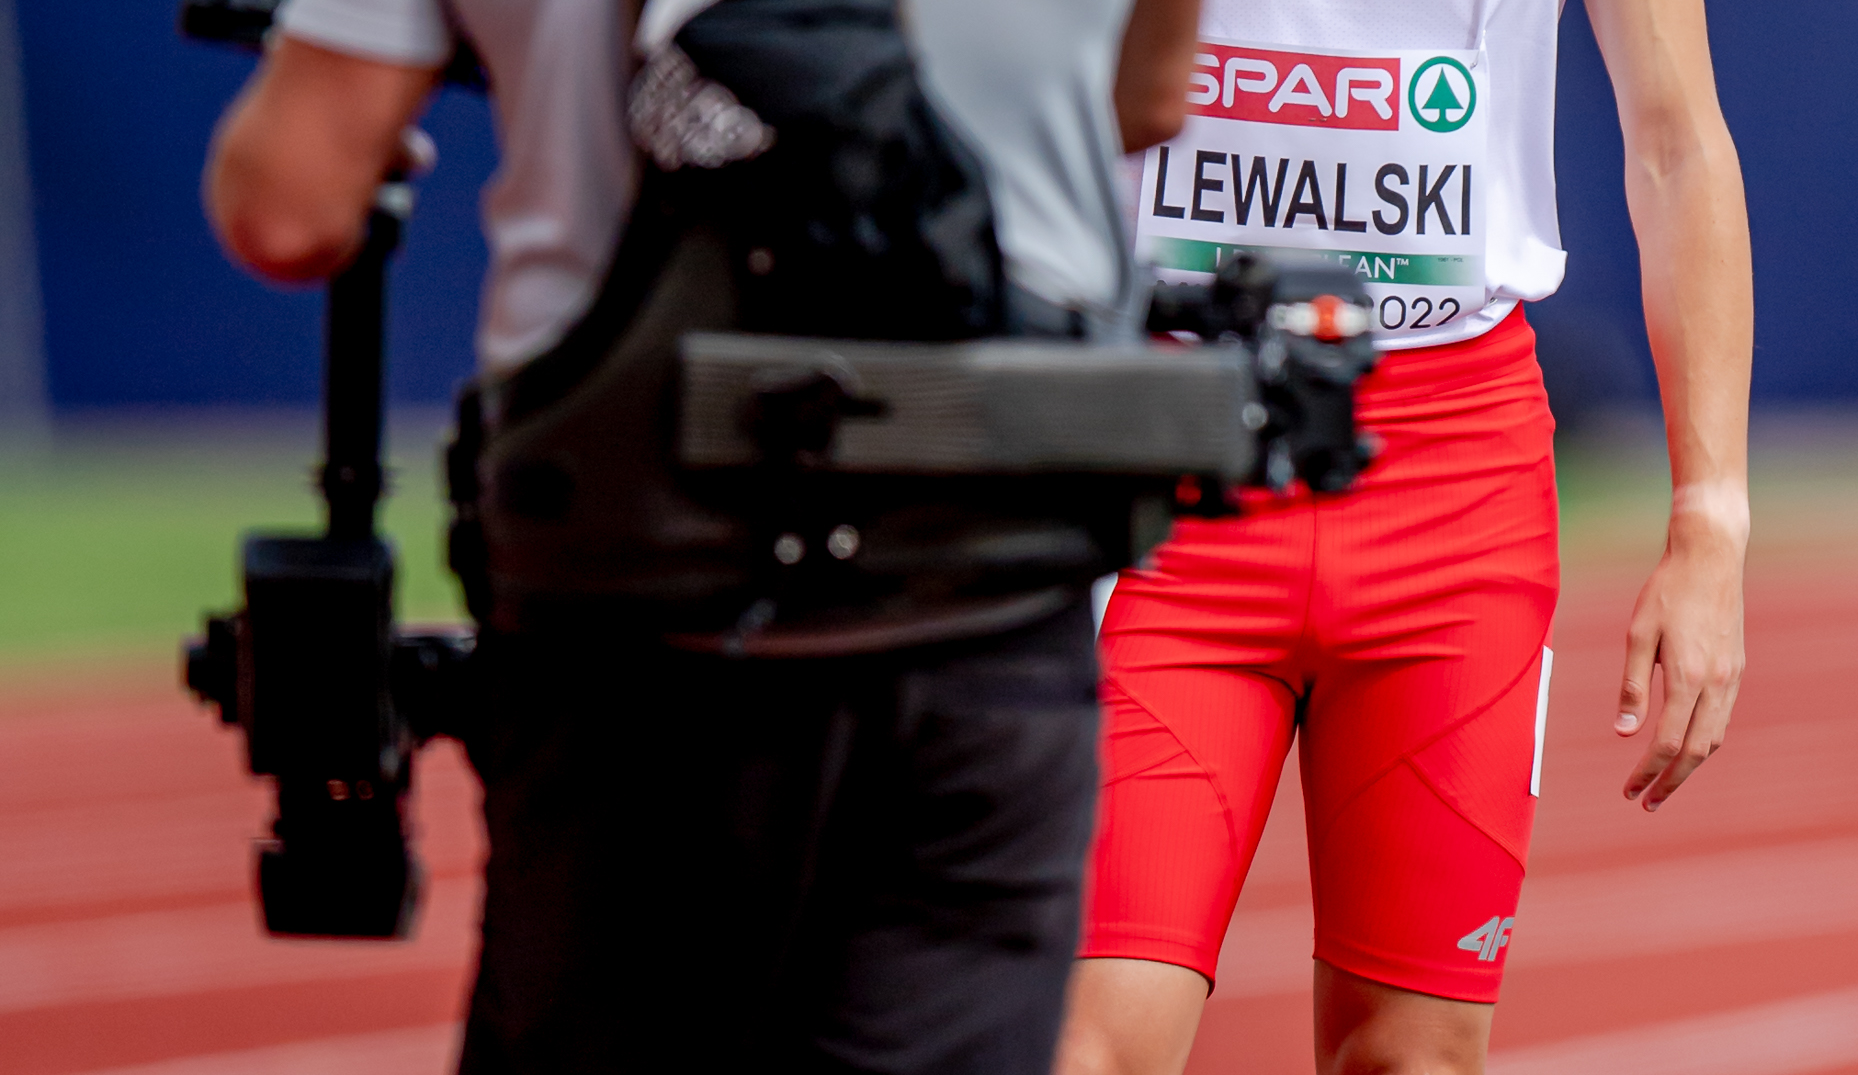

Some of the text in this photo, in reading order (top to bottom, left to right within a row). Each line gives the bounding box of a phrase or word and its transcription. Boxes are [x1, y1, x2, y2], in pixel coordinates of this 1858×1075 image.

[1186, 53, 1394, 120] SPAR
[1153, 146, 1471, 236] LEWALSKI
[1366, 294, 1461, 330] 022
[1457, 915, 1516, 961] 4F
